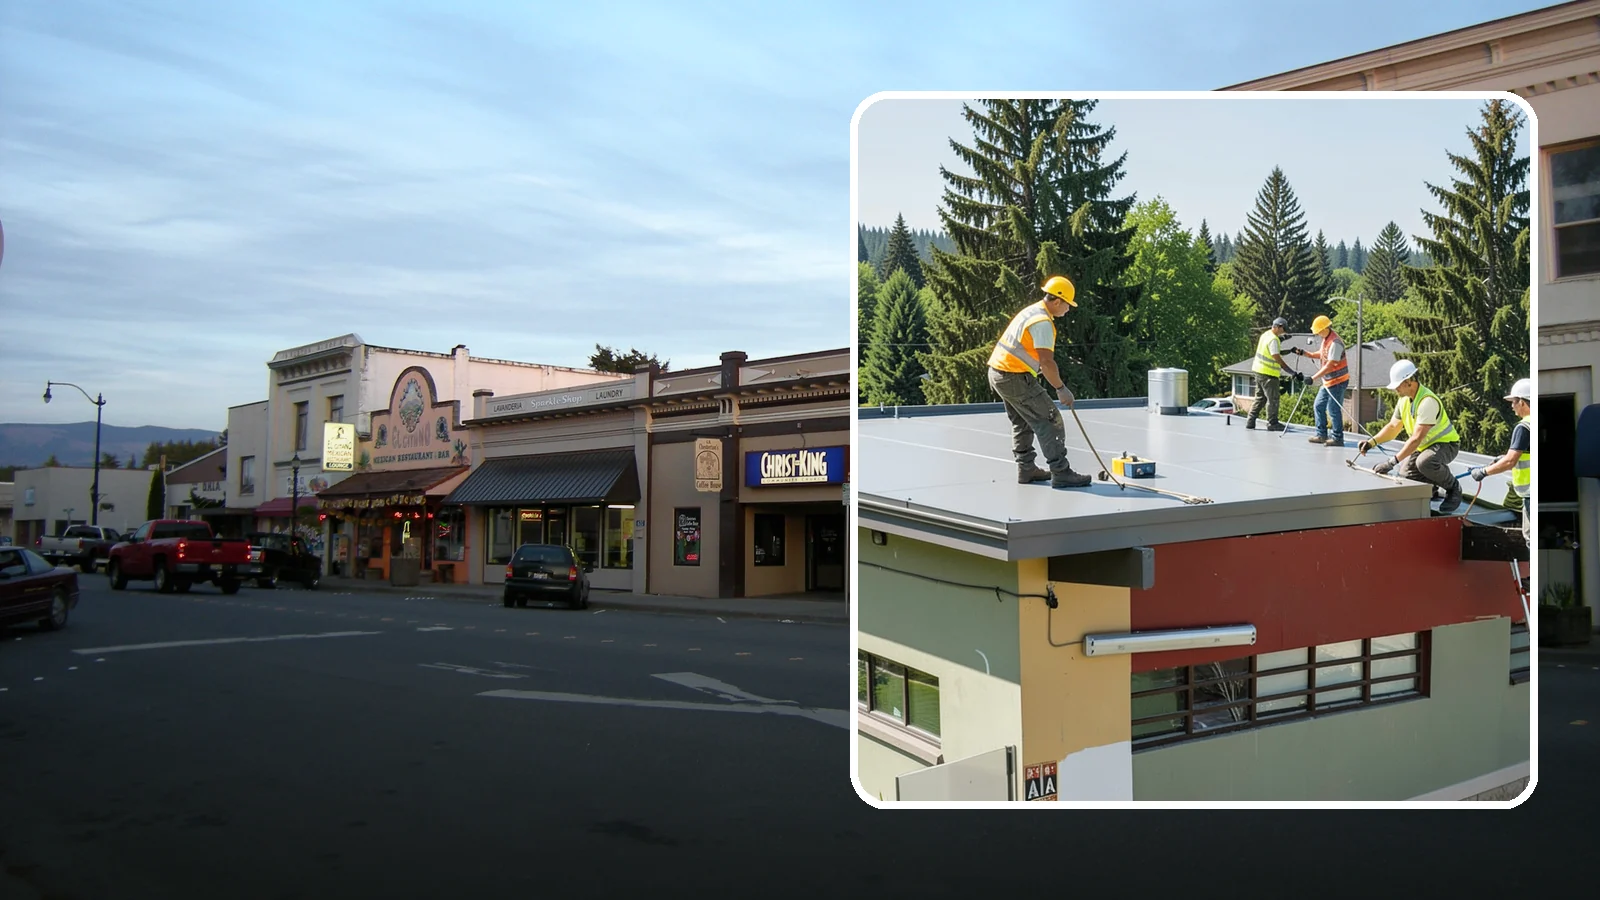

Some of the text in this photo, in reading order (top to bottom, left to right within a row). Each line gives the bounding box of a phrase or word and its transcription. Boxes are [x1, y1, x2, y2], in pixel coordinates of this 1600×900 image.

[595, 388, 623, 400] LAUNDRY
[493, 402, 523, 413] LAVANDERIA
[530, 394, 583, 409] Sparkle Shop
[373, 450, 450, 464] MEXICAN RESTAURANT BAR
